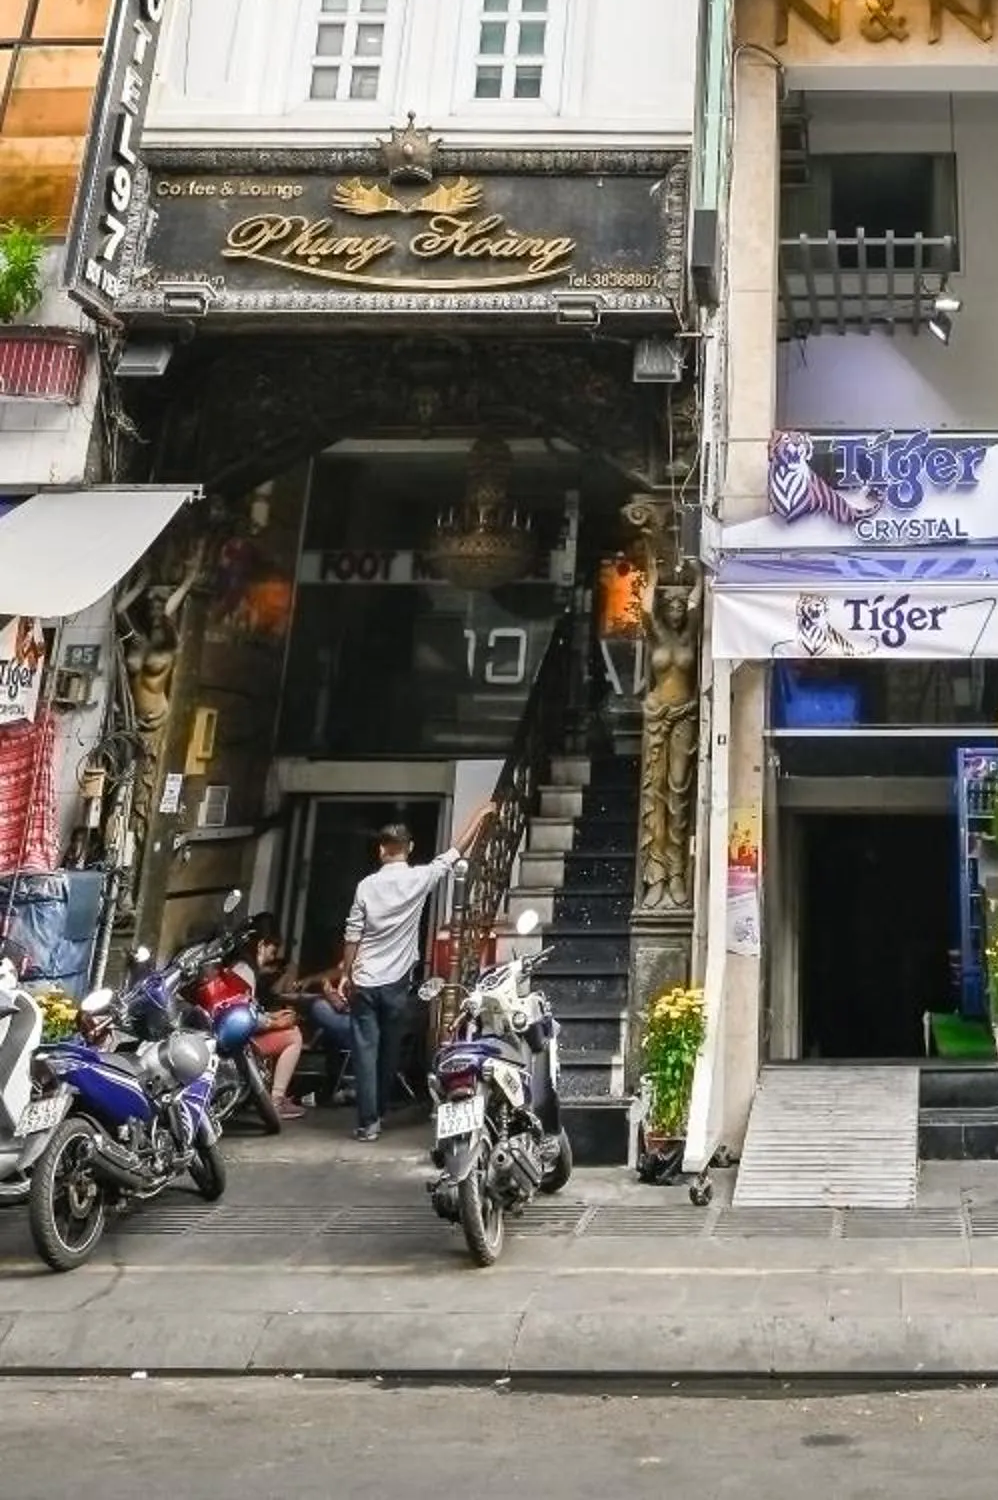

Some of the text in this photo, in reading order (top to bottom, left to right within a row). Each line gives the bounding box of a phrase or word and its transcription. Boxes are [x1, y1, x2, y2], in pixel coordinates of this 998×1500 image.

[104, 166, 132, 263] 97
[220, 181, 235, 197] &
[408, 212, 577, 273] Hoàng
[832, 430, 986, 511] Tiger
[855, 517, 969, 541] CRYSTAL
[843, 594, 948, 649] Tiger
